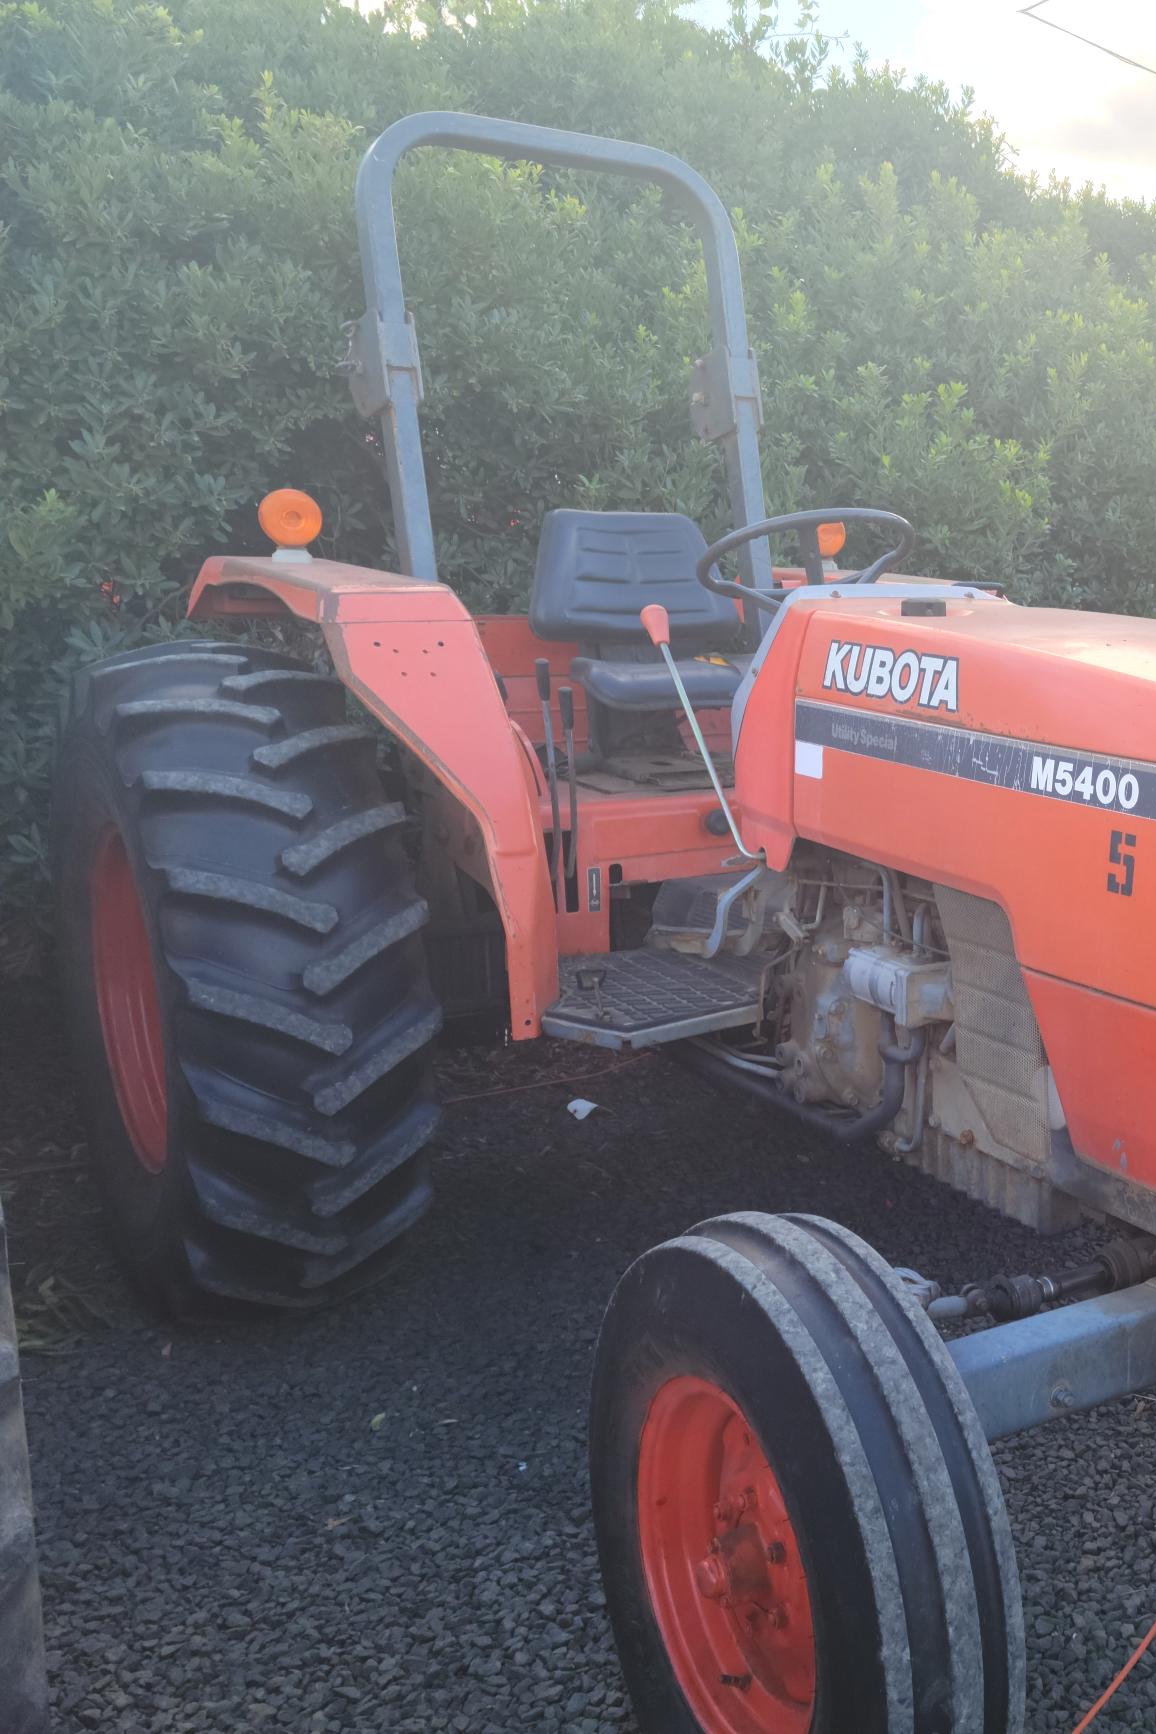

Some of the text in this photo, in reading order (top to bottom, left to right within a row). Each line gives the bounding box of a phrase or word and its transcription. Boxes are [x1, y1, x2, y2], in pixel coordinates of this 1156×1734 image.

[823, 640, 959, 712] KUBOTA
[831, 722, 897, 752] Utility Special
[1031, 757, 1139, 810] M5400
